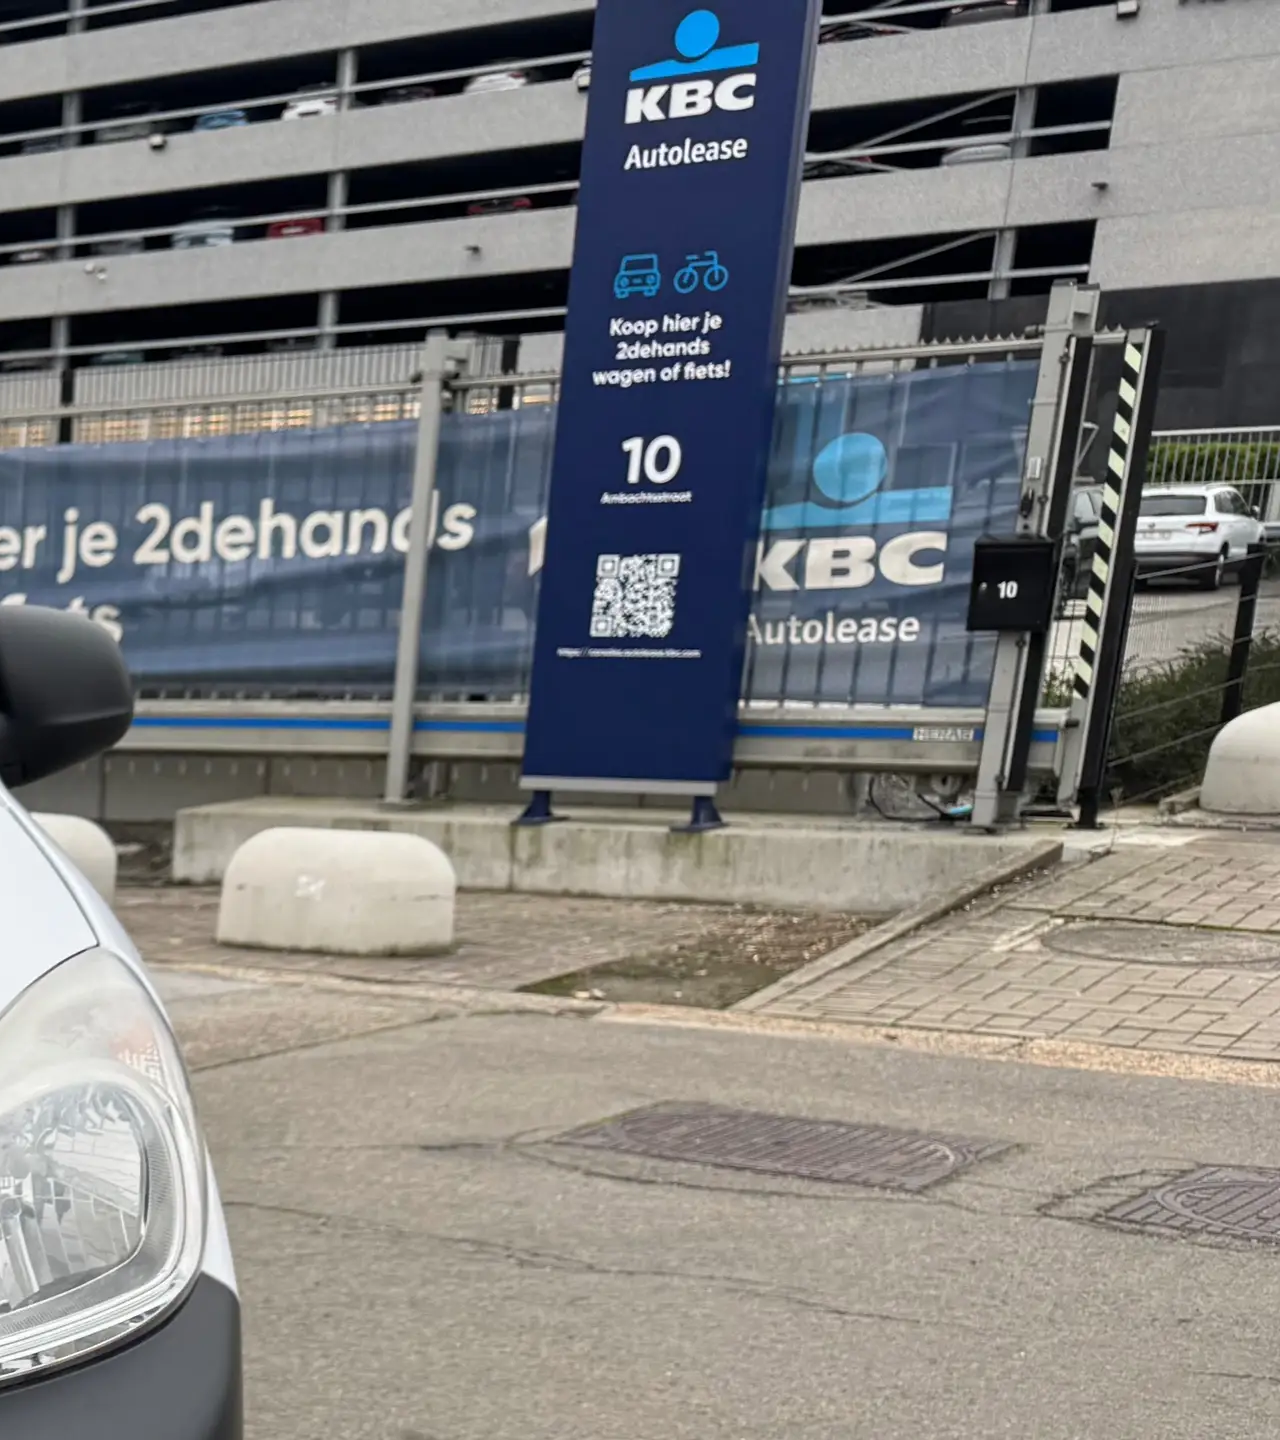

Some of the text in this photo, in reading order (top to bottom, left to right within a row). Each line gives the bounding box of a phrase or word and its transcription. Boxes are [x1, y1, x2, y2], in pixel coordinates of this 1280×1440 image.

[624, 73, 757, 124] KBC
[624, 137, 748, 171] Autolease
[609, 310, 723, 338] Koop hier je
[615, 336, 711, 360] 2dehands
[592, 359, 731, 388] wagen of fiets!
[621, 434, 682, 485] 10
[56, 507, 118, 585] je
[752, 531, 948, 591] KBC
[997, 580, 1019, 599] 10
[747, 611, 921, 645] Autolease
